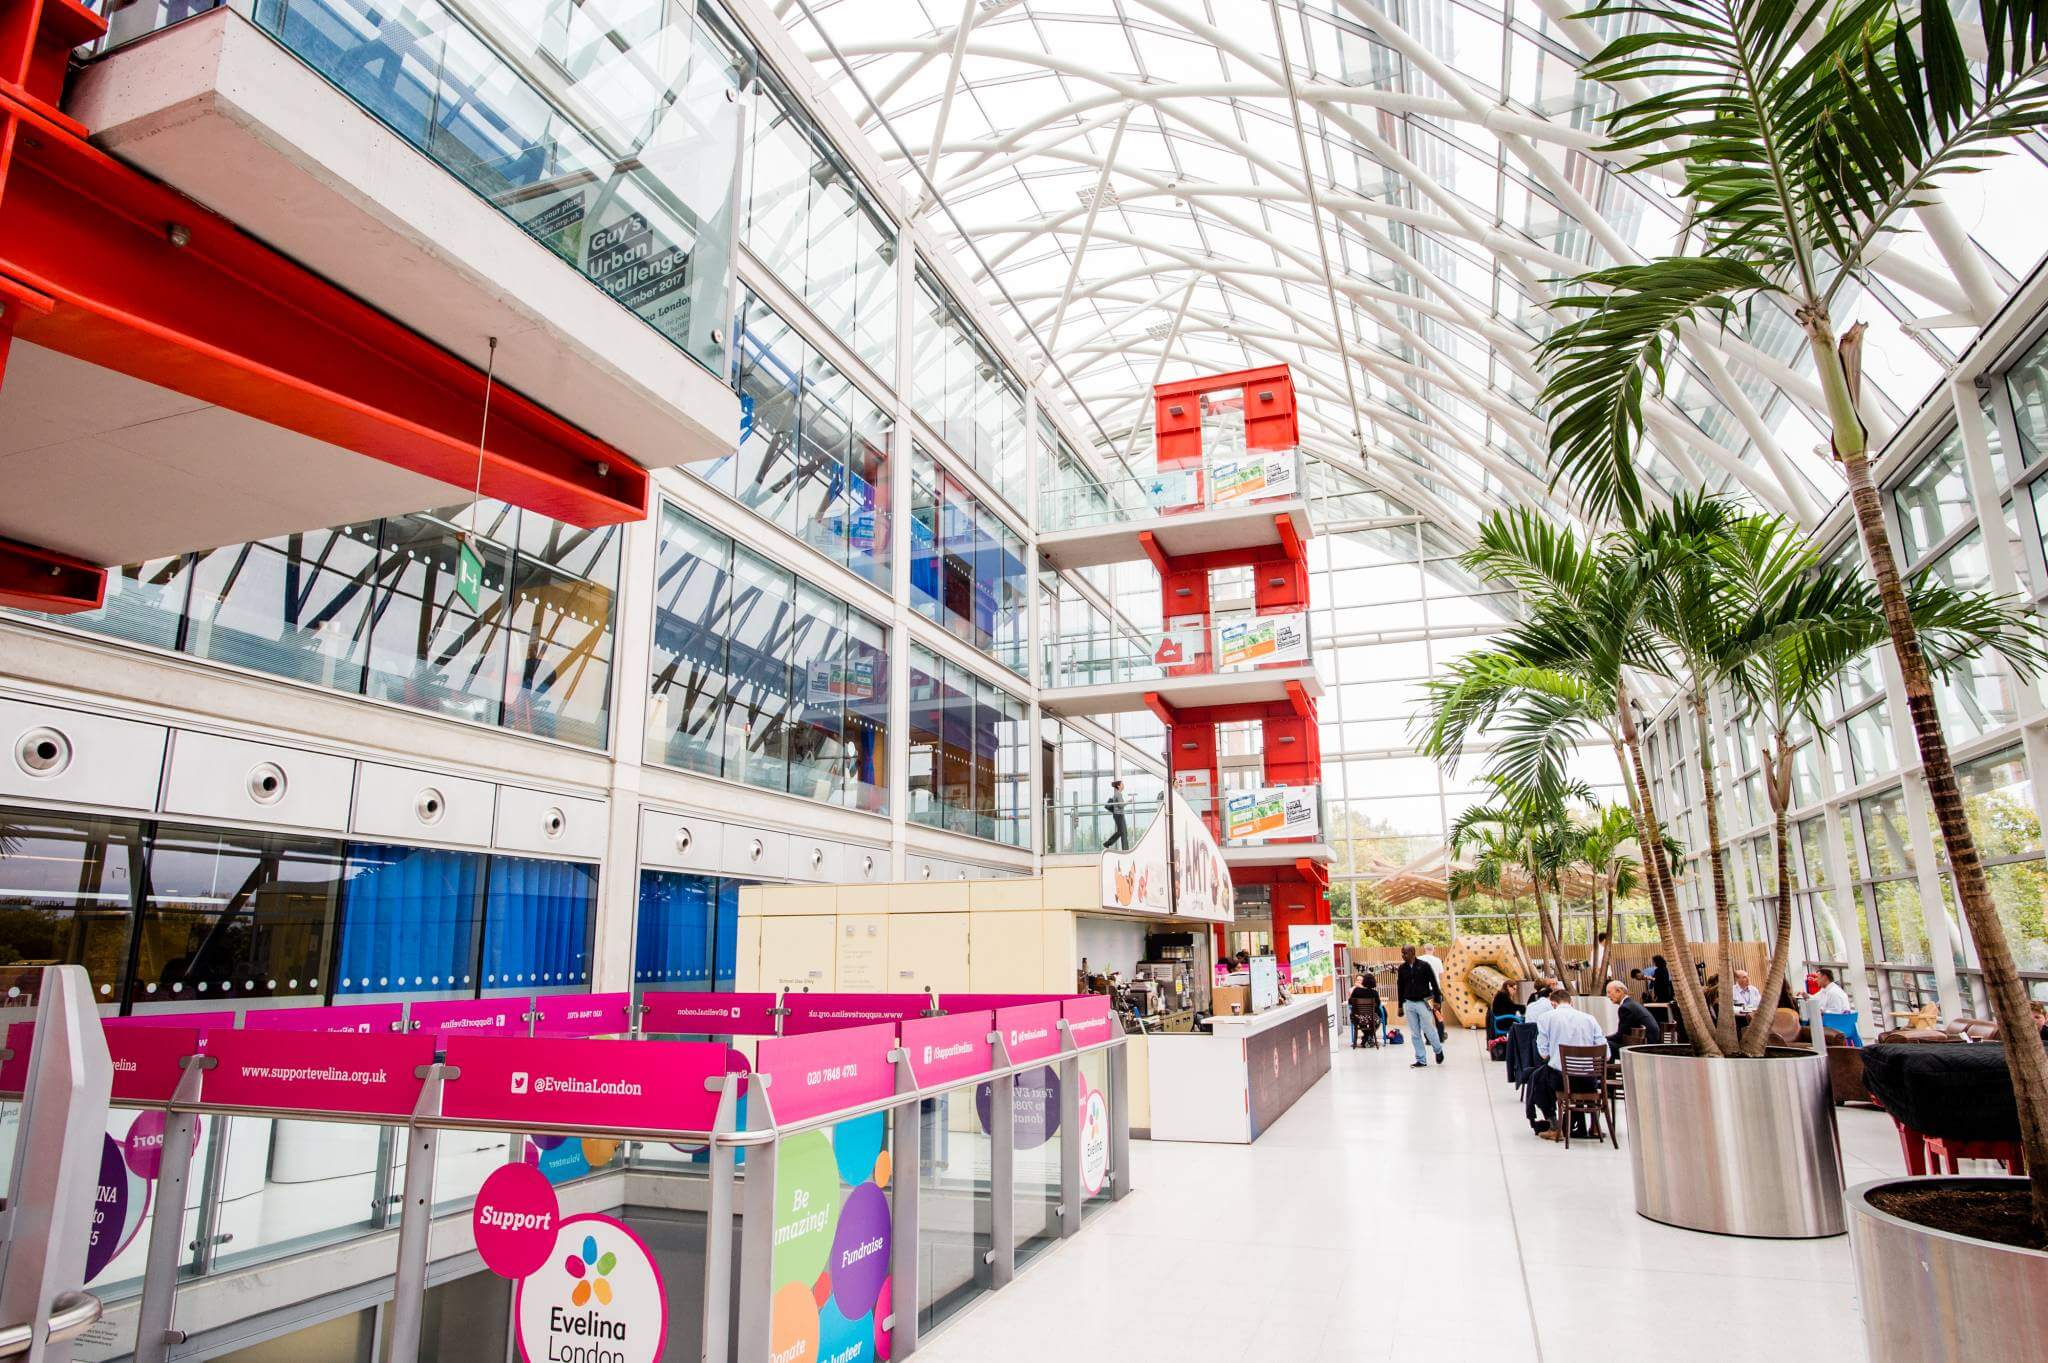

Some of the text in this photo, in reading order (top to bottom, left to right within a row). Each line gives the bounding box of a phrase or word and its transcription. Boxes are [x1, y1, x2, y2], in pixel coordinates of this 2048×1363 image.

[592, 215, 642, 251] Guy's
[590, 241, 647, 279] Urban
[604, 250, 686, 295] hallenge
[659, 273, 683, 292] 2017
[242, 1064, 387, 1086] www.supportevelina.org.uk
[534, 1076, 642, 1096] @EvelinaLondon
[807, 1063, 858, 1086] 020 7848 4701
[792, 1188, 809, 1213] Be
[480, 1205, 551, 1231] Support
[842, 1236, 884, 1269] Fundraise
[551, 1306, 626, 1340] Evelina
[549, 1335, 625, 1363] London
